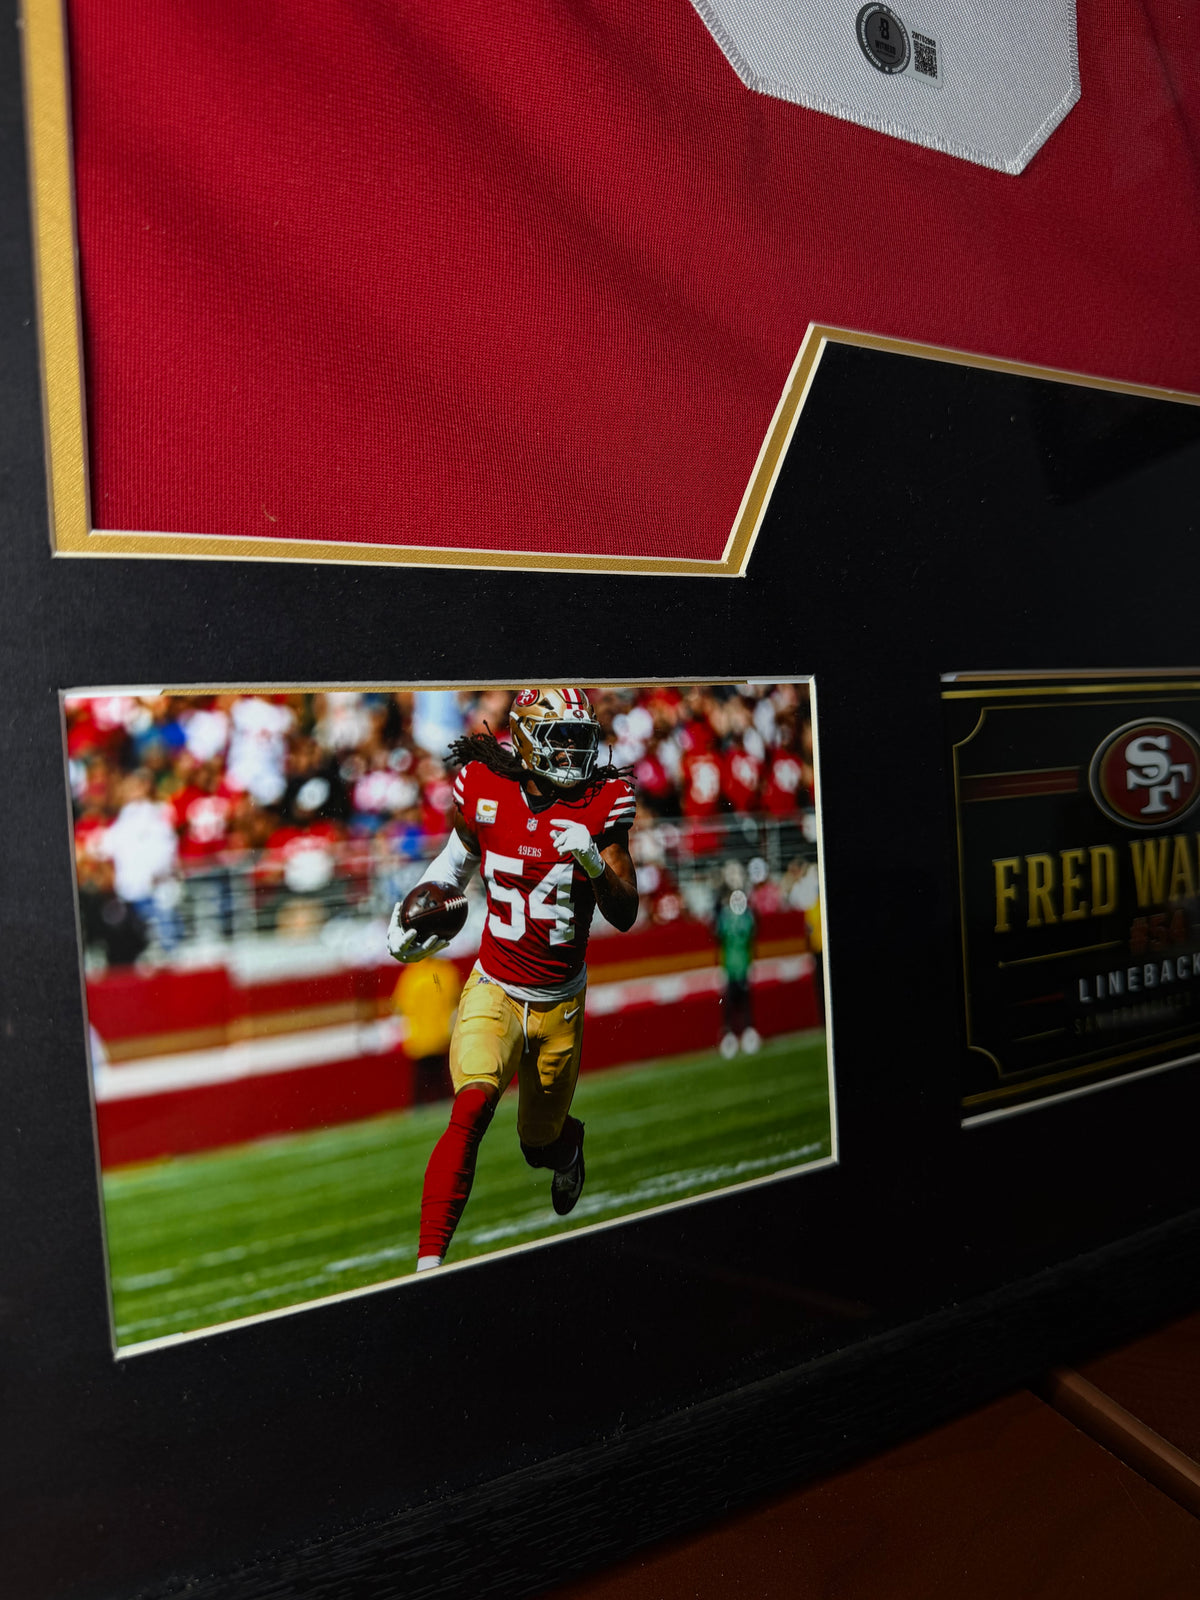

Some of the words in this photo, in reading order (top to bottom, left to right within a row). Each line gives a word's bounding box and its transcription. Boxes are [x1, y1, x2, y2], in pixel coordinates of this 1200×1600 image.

[484, 850, 575, 946] 54
[517, 845, 542, 858] 49ERS
[992, 843, 1119, 934] FRED
[1129, 831, 1200, 910] WA
